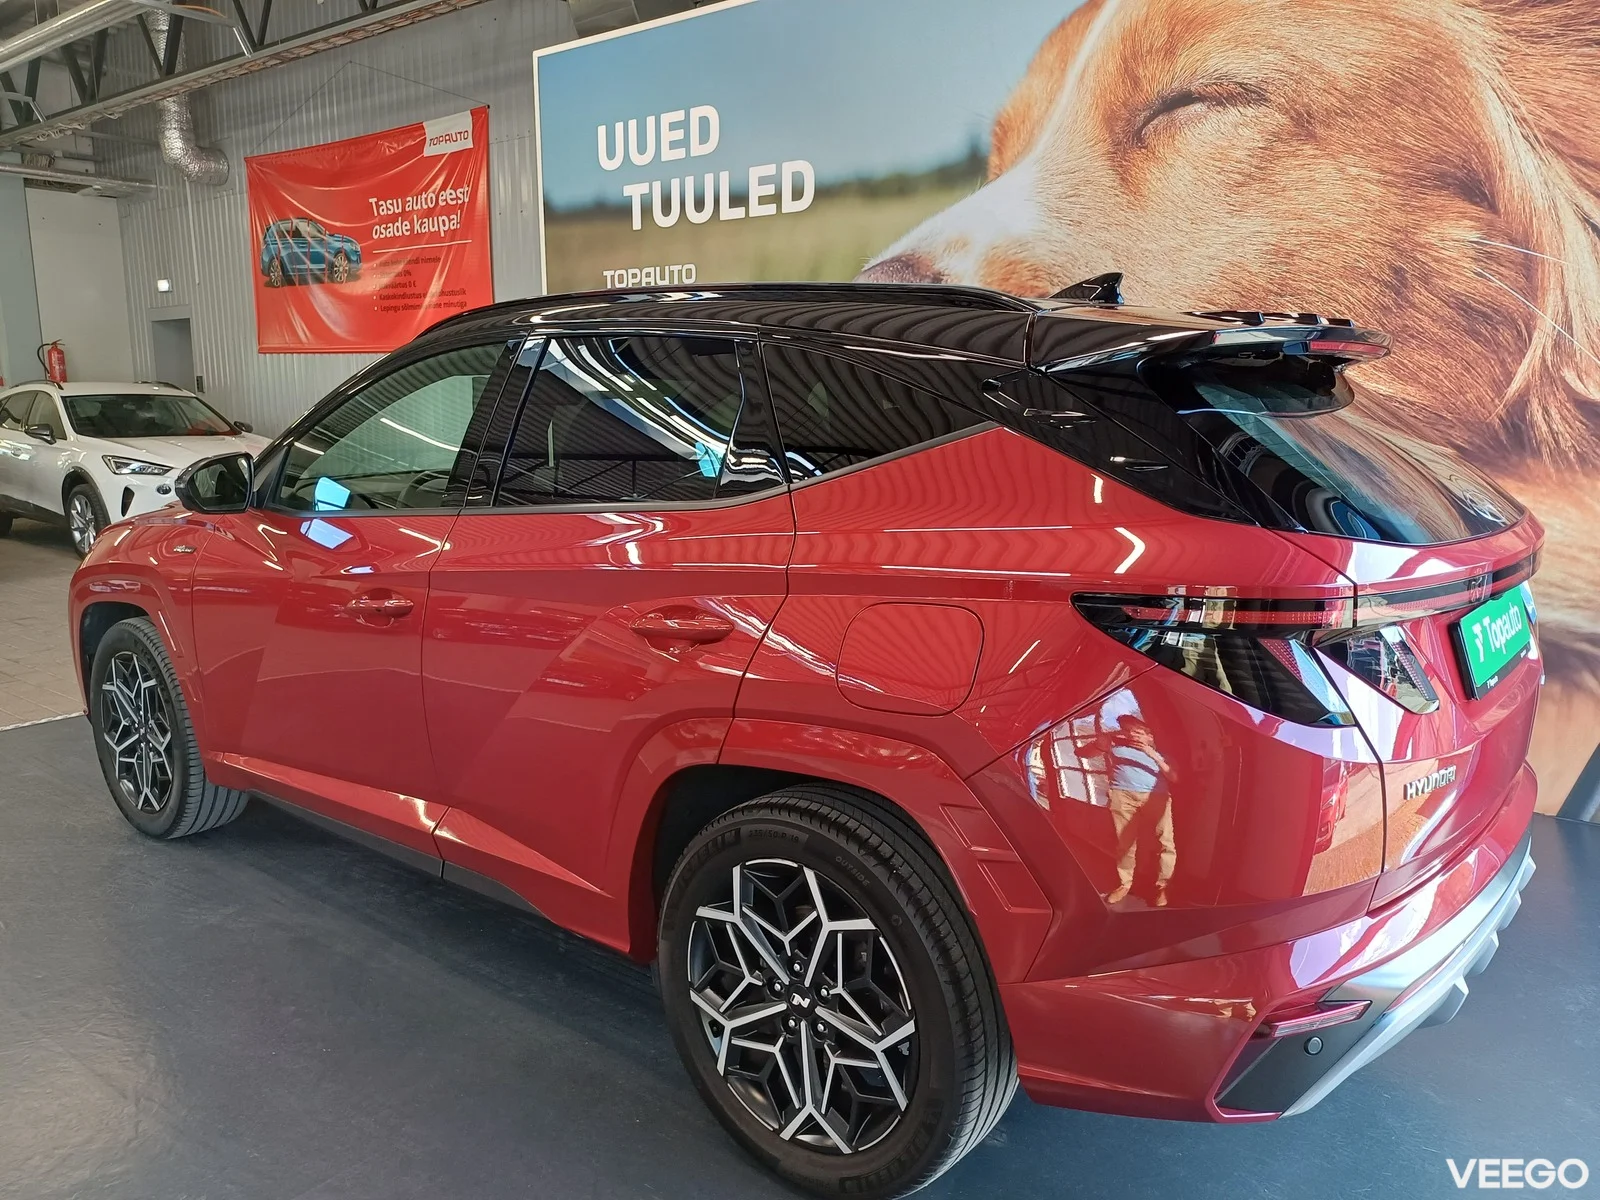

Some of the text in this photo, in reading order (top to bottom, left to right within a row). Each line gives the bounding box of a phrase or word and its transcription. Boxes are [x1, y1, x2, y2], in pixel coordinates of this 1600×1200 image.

[428, 130, 469, 147] TOPAUTO
[597, 104, 720, 171] UUED
[369, 184, 469, 216] Tasu auto eest
[623, 159, 815, 231] TUULED
[372, 209, 461, 240] osade kaupa!
[603, 264, 697, 289] TOPAUTO
[1482, 602, 1523, 654] Topauto
[835, 855, 870, 887] OUTSIDE
